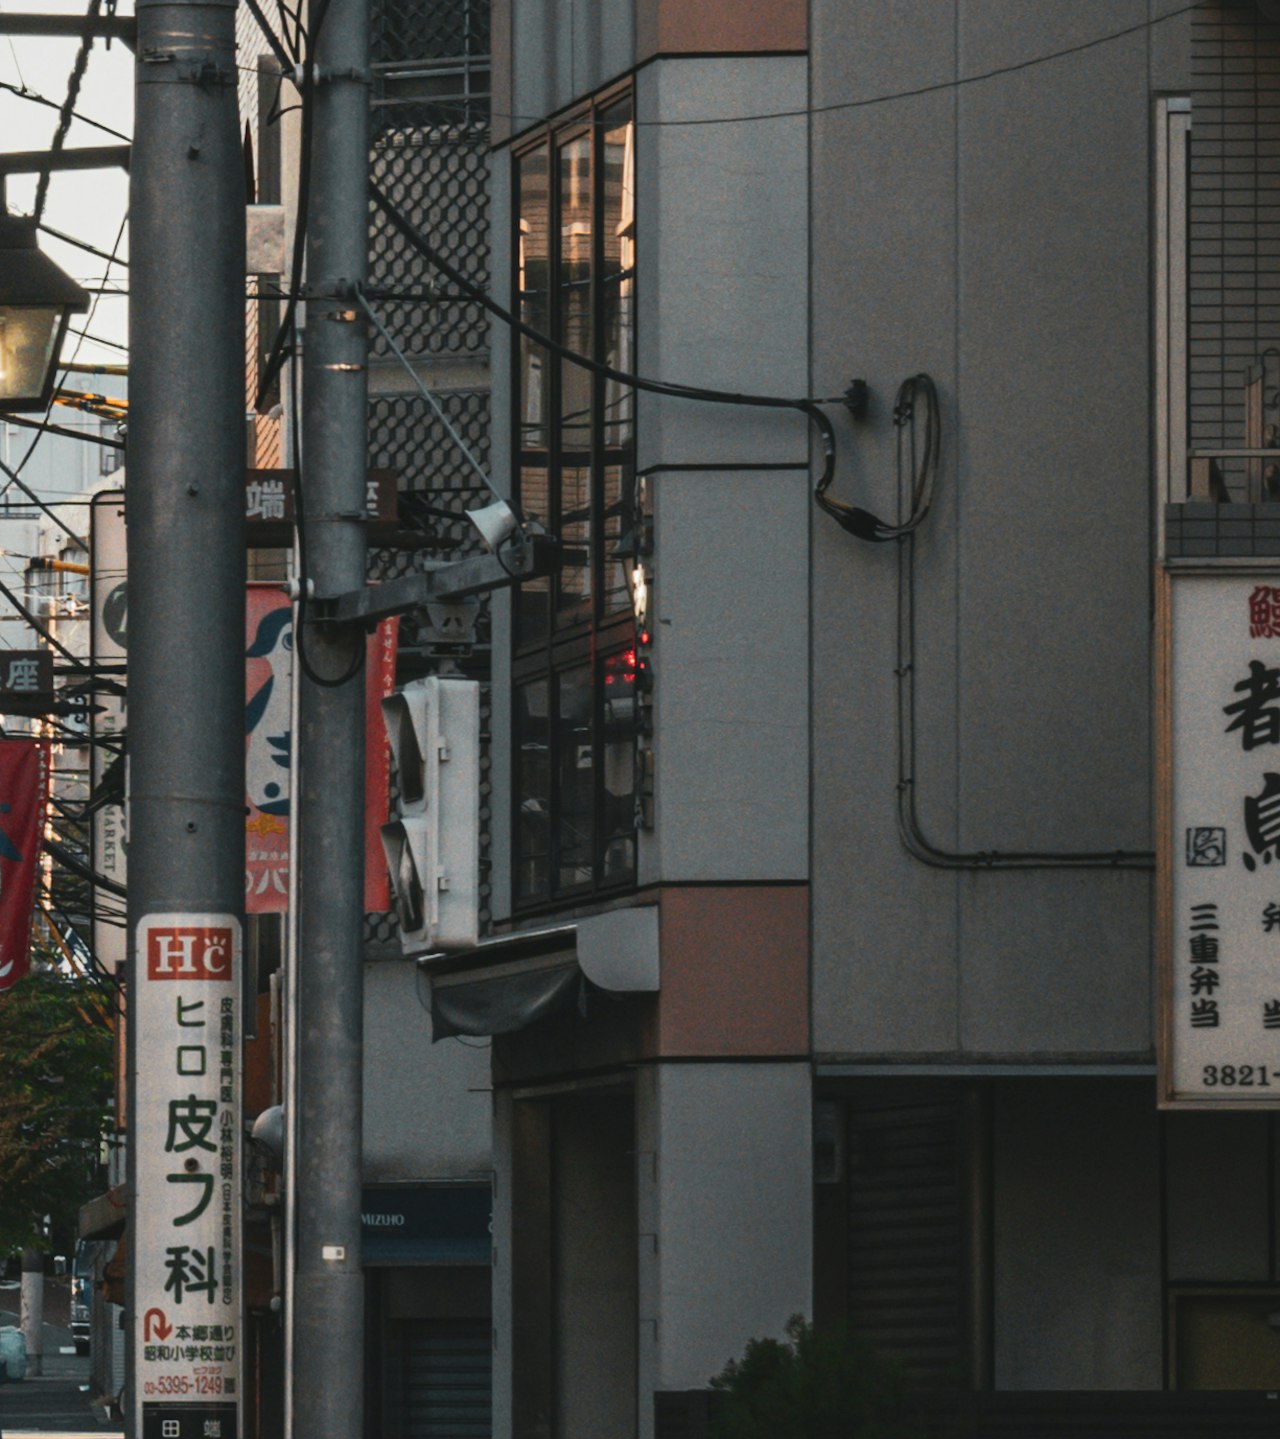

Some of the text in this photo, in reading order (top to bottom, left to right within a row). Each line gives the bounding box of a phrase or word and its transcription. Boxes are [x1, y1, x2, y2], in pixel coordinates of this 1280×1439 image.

[1189, 904, 1220, 1028] 三重弁当
[165, 995, 218, 1304] ヒロ皮フ科
[144, 1345, 236, 1362] 昭和小学校並び
[175, 1325, 235, 1342] 本郷通り
